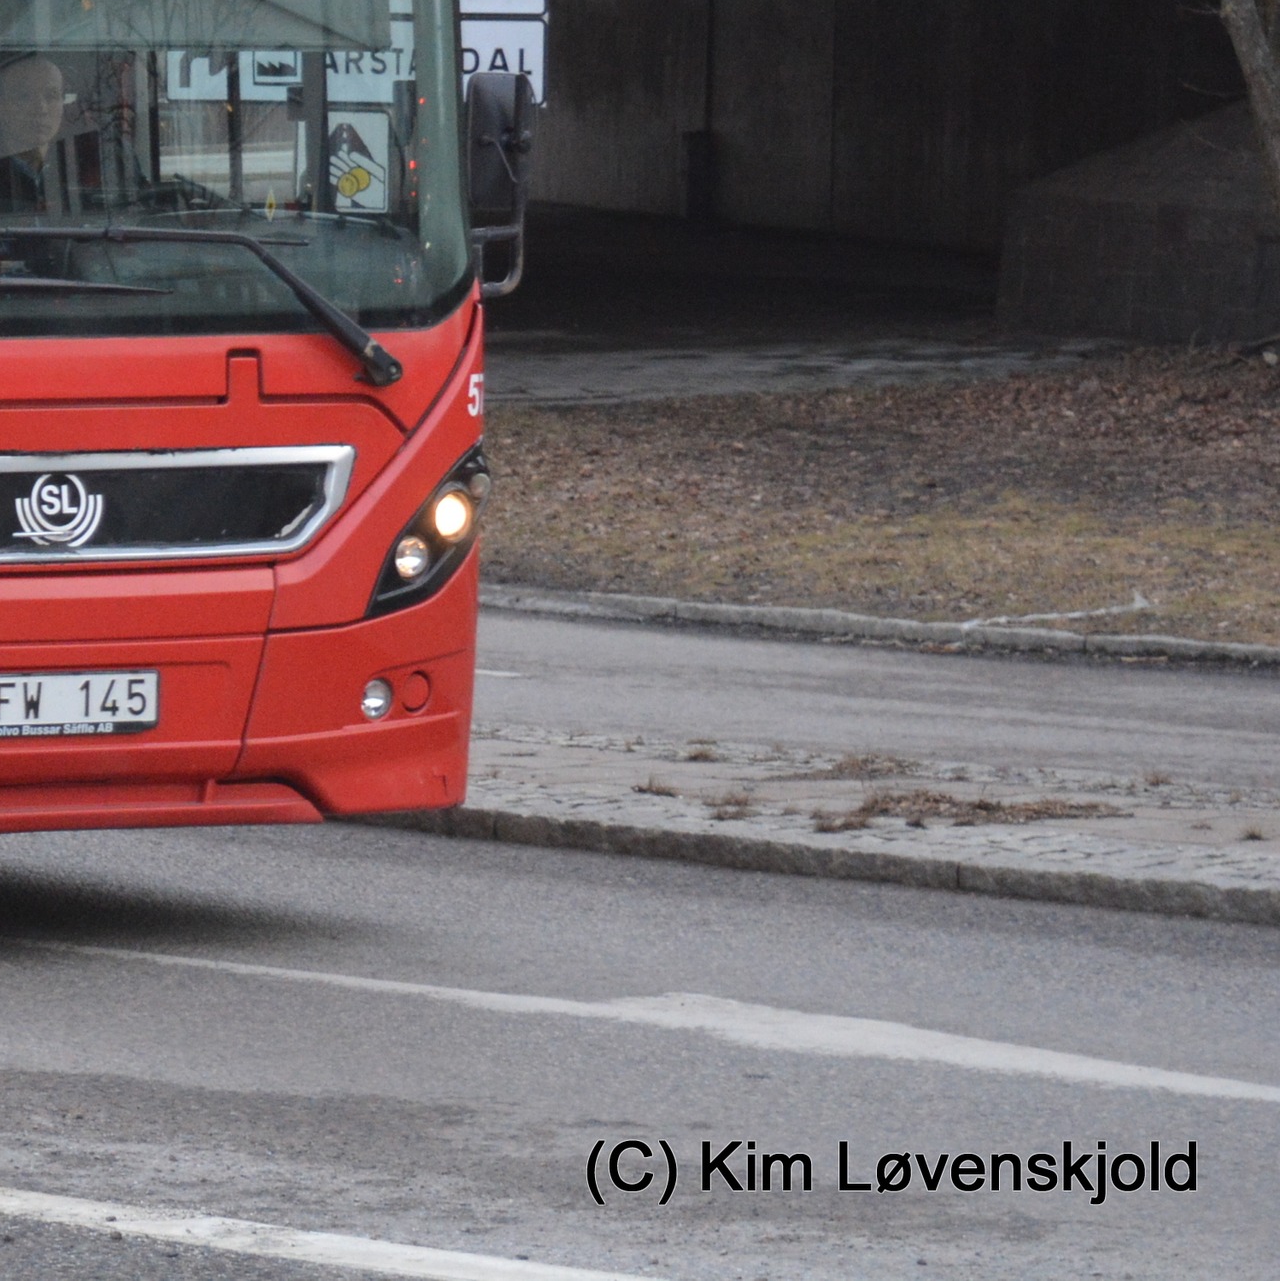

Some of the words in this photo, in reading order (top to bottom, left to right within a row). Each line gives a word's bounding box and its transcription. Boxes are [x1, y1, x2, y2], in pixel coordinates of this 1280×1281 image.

[41, 484, 78, 515] SL
[79, 679, 147, 718] 145
[21, 724, 61, 735] Bussar
[97, 722, 114, 733] AB
